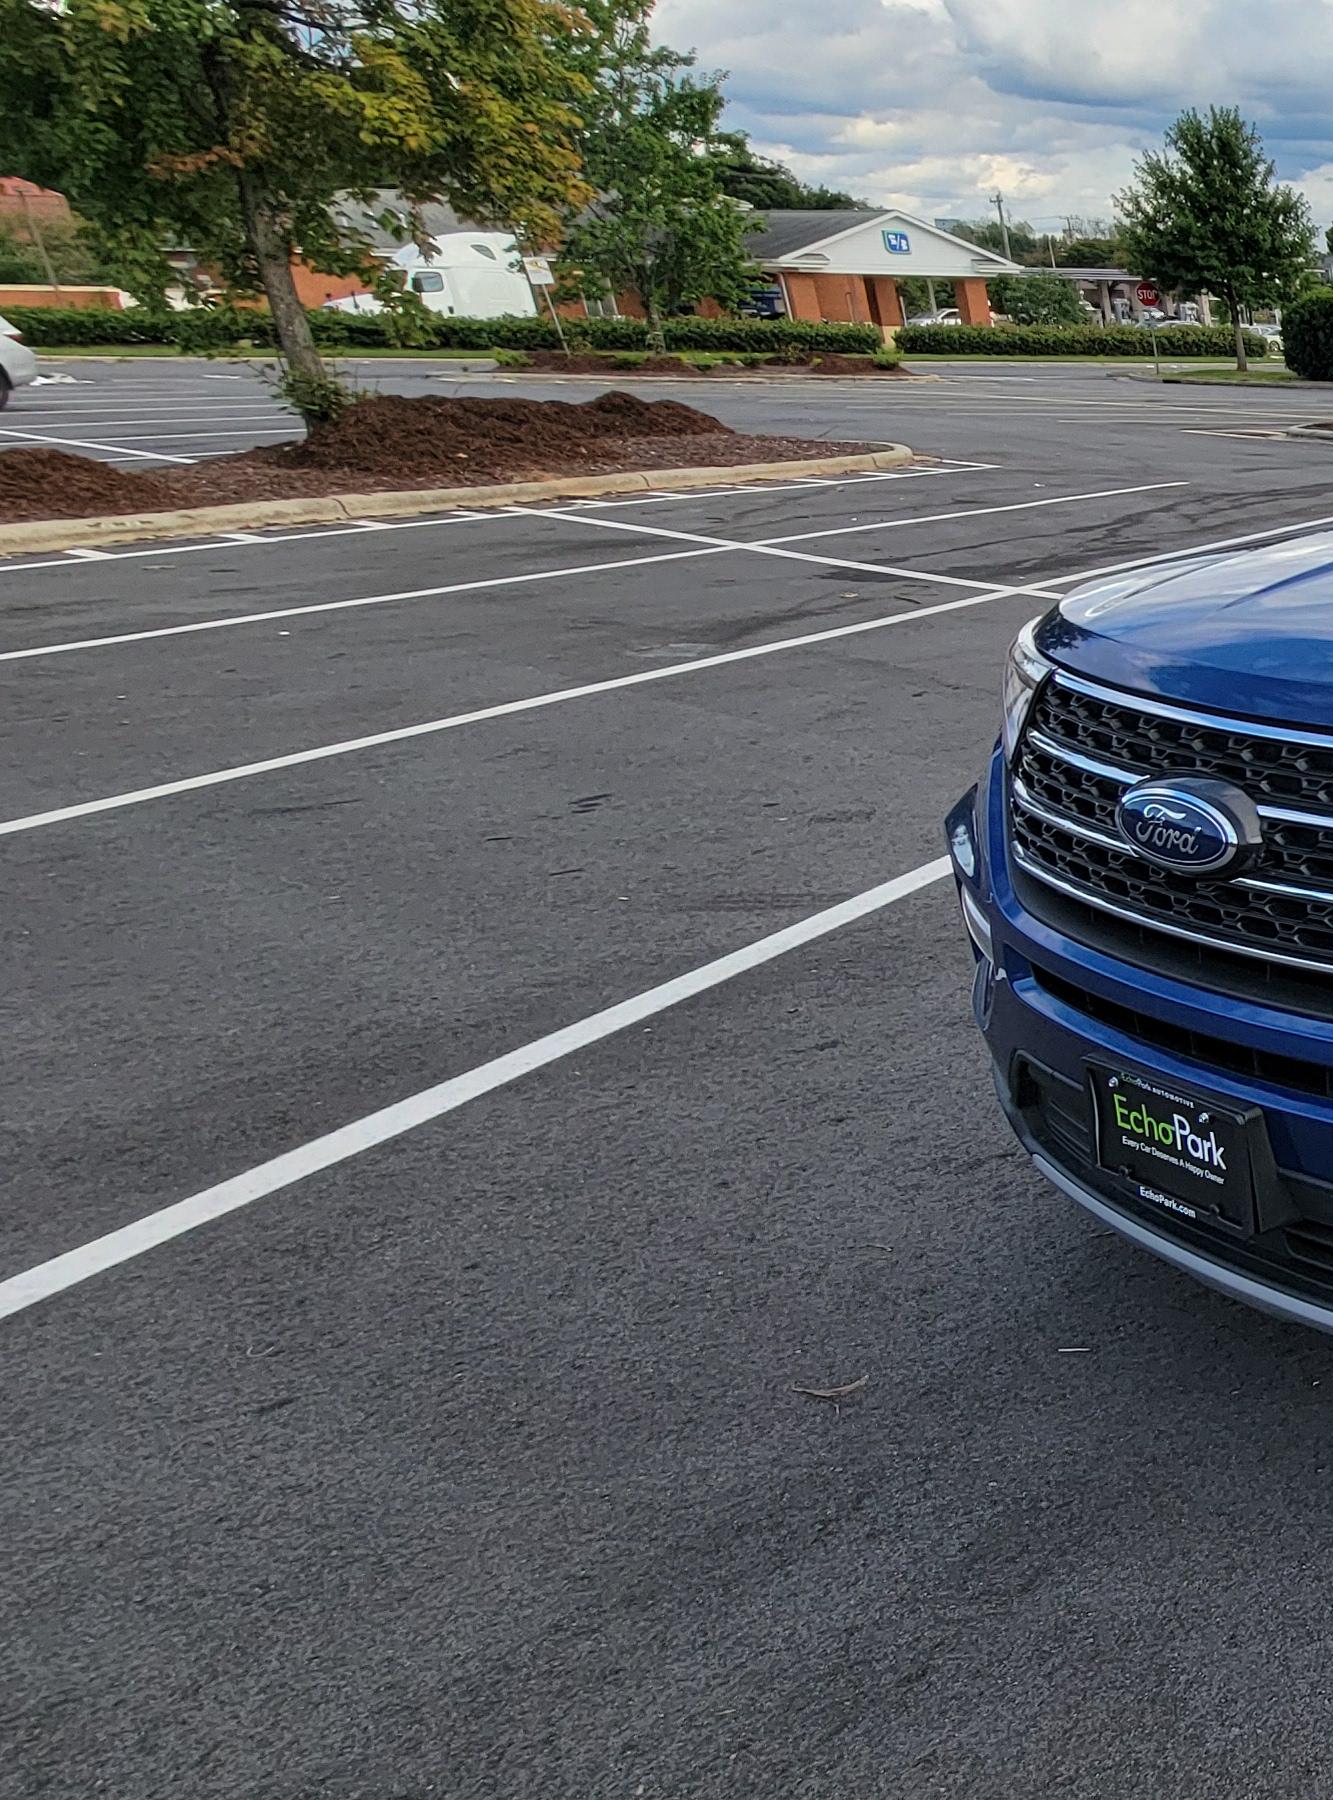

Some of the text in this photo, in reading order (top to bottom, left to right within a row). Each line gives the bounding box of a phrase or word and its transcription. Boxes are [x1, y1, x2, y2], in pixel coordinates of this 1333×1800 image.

[1137, 289, 1157, 300] STOP
[1135, 803, 1202, 855] Ford
[1113, 1093, 1227, 1171] EchoPark
[1122, 1135, 1140, 1151] Every
[1140, 1142, 1151, 1154] Car
[1151, 1146, 1179, 1166] Deserves
[1186, 1160, 1204, 1179] Happy
[1204, 1170, 1225, 1186] Owner
[1139, 1186, 1196, 1219] EchoPark.com
